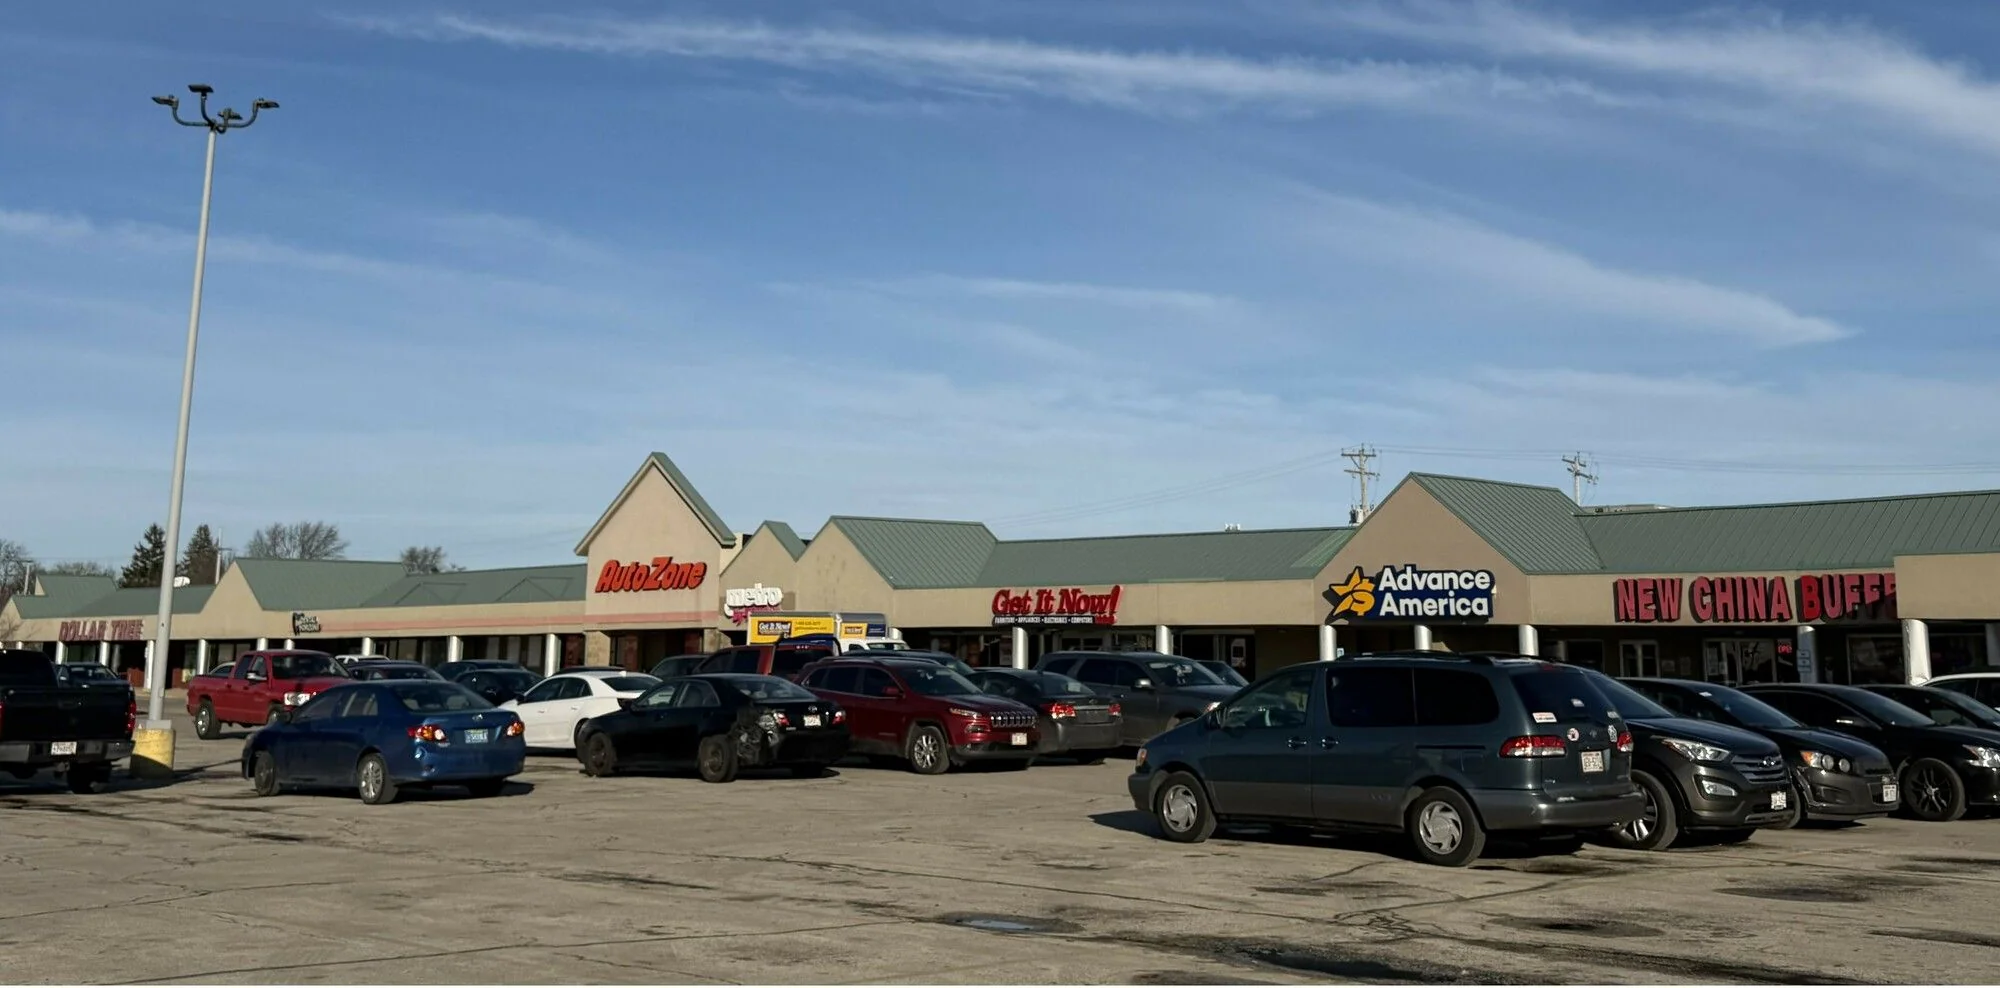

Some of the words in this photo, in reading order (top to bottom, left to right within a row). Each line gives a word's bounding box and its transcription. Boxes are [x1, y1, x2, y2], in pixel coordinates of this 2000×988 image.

[595, 556, 708, 593] AutoZone
[1378, 566, 1492, 592] Advance
[725, 583, 783, 608] metro
[992, 588, 1032, 616] Get
[1033, 588, 1056, 615] It
[1056, 584, 1121, 616] Now!
[1379, 591, 1489, 616] America
[1614, 577, 1683, 622] NEW
[1690, 575, 1793, 622] CHINA
[59, 620, 107, 641] DOLLAR
[111, 619, 144, 640] TREE
